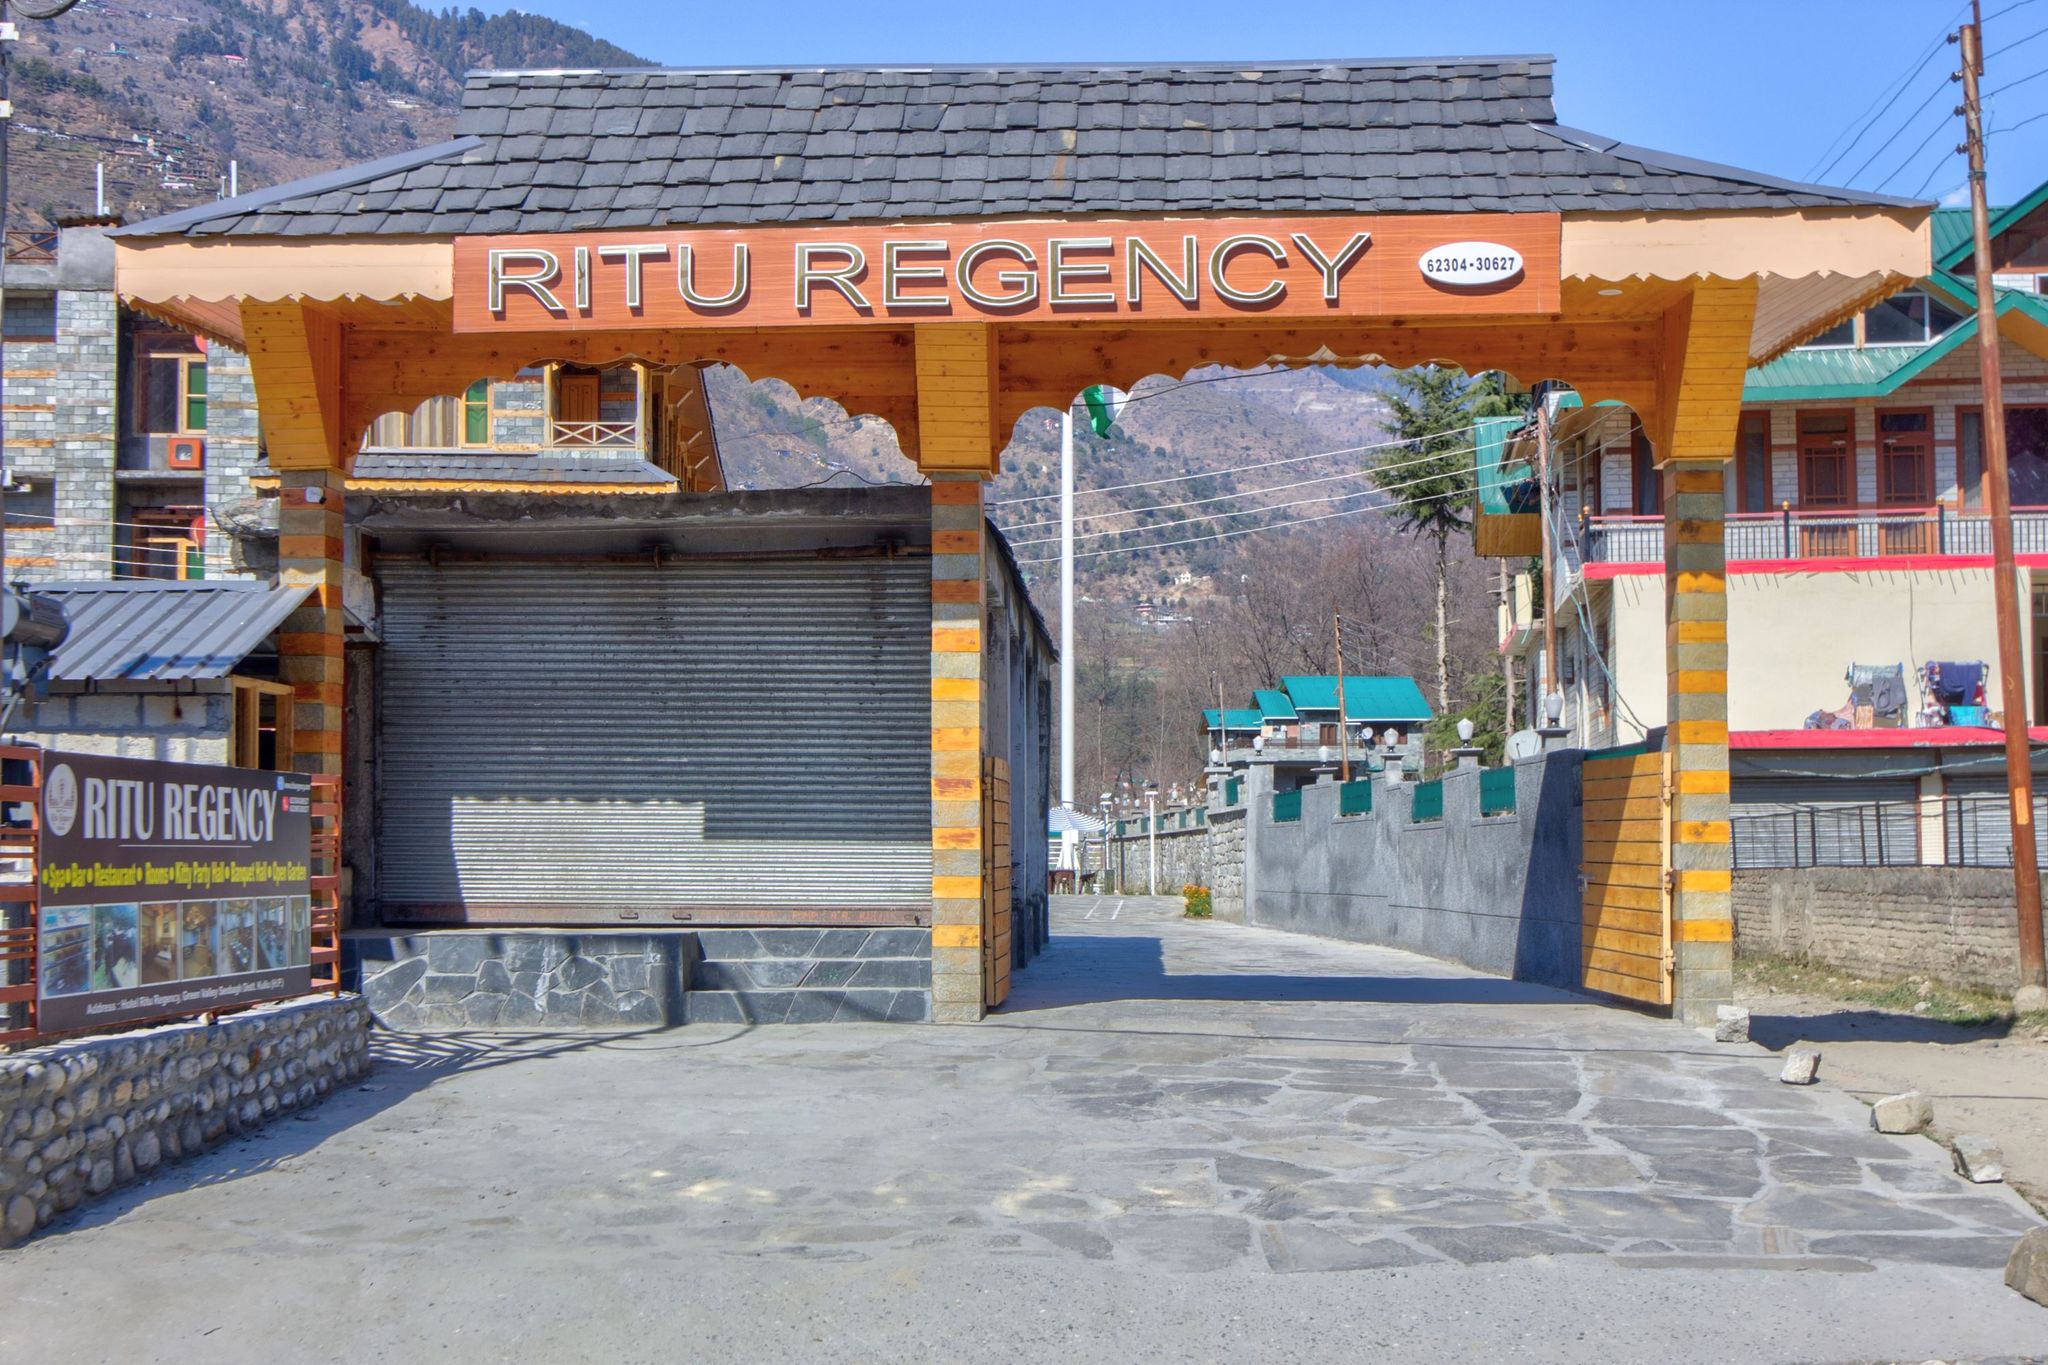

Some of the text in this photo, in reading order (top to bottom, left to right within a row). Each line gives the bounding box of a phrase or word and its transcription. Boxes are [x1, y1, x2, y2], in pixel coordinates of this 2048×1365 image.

[488, 232, 1372, 312] RITU REGENCY
[1427, 257, 1515, 273] 62304-30627
[84, 777, 278, 842] RITU REGENCY
[71, 862, 86, 887] Bar
[94, 862, 136, 887] Restaurant
[145, 861, 169, 885] Rooms
[193, 861, 211, 889] Party
[212, 861, 225, 883] Hall
[256, 861, 268, 882] Hall
